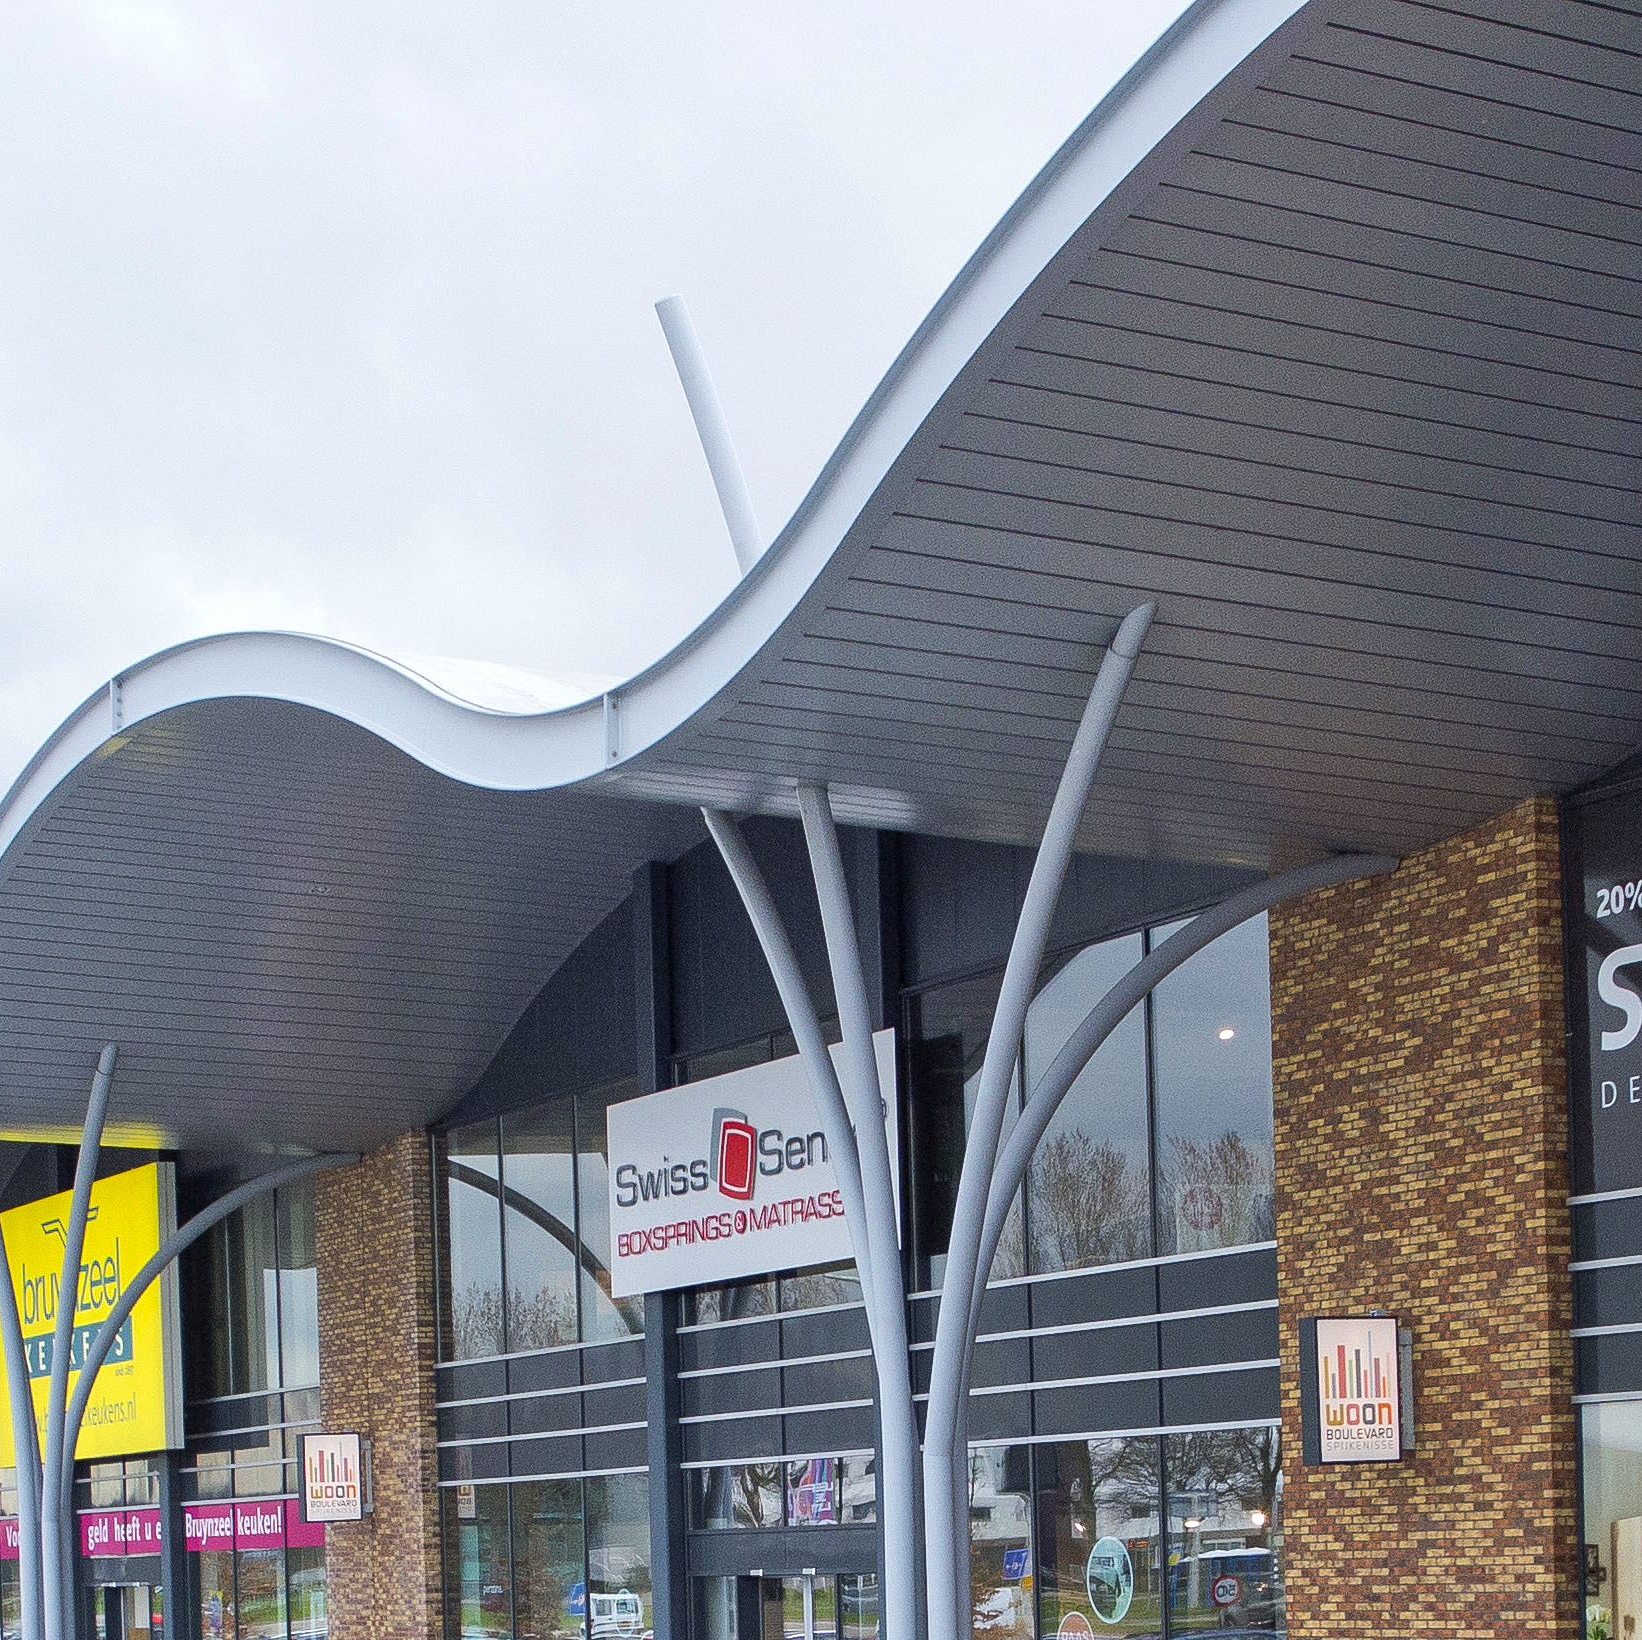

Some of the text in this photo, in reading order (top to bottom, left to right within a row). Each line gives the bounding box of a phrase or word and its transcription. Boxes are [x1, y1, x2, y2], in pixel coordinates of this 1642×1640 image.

[1601, 1075, 1641, 1109] DE
[616, 1155, 709, 1208] Swiss
[617, 1210, 732, 1257] BOXSPRINGS
[748, 1189, 845, 1232] MATRASS
[22, 1237, 122, 1324] bruzeel
[1326, 1427, 1394, 1440] BOULEVARD
[1326, 1440, 1395, 1451] SPIJKENISSE
[88, 1517, 108, 1550] geld
[145, 1522, 152, 1540] u
[185, 1508, 233, 1545] Bruynzeel
[237, 1506, 282, 1536] keuken!
